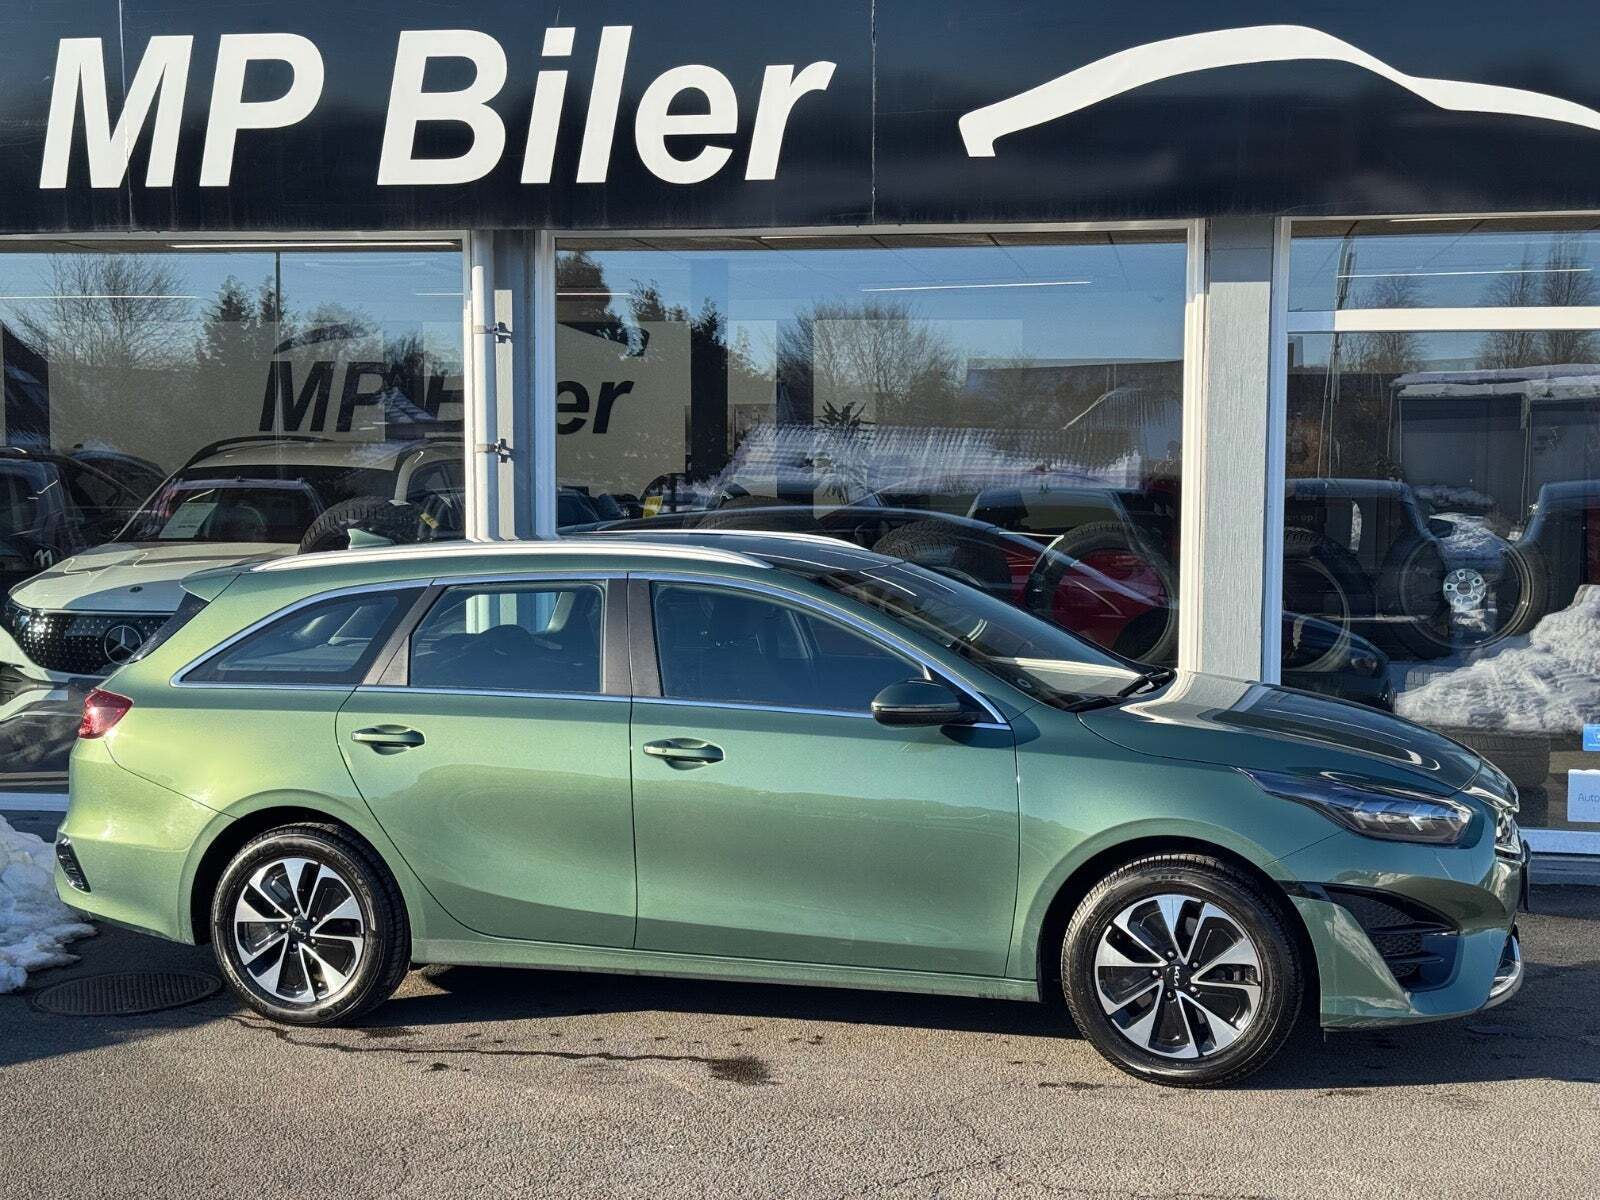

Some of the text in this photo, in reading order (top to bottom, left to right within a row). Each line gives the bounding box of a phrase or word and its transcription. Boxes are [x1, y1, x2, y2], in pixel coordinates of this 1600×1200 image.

[40, 26, 836, 190] MP Biler
[259, 361, 386, 433] MP
